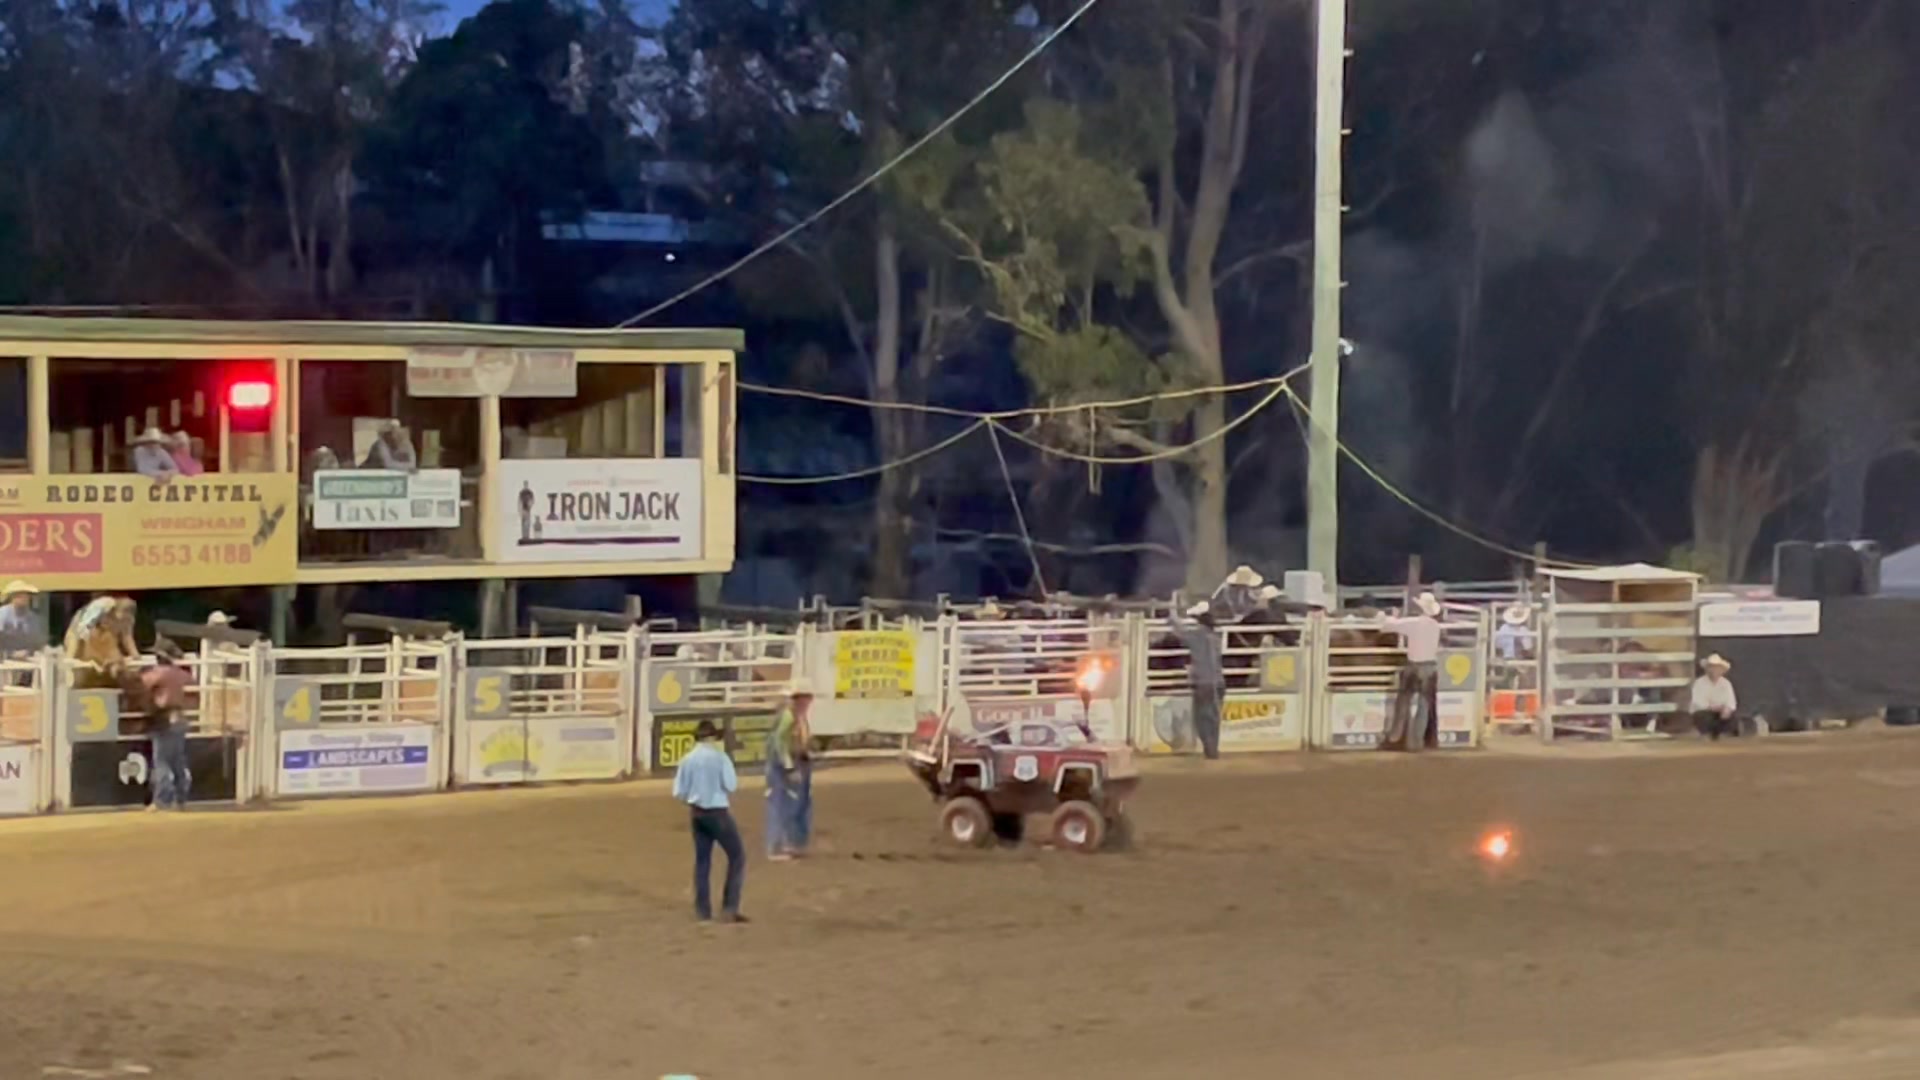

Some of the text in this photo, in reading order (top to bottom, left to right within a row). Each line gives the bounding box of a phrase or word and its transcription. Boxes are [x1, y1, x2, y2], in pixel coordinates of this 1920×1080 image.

[46, 484, 262, 503] RODEO CAPITAL
[546, 491, 680, 521] IRON JACK
[141, 516, 246, 530] WINGHAM
[334, 501, 399, 523] Taxis
[131, 543, 252, 567] 6553 4188
[1445, 654, 1472, 686] 9
[474, 676, 502, 714] 5
[656, 670, 682, 704] 6
[75, 695, 109, 733] 3
[282, 686, 312, 724] 4
[306, 748, 406, 767] LANDSCAPES
